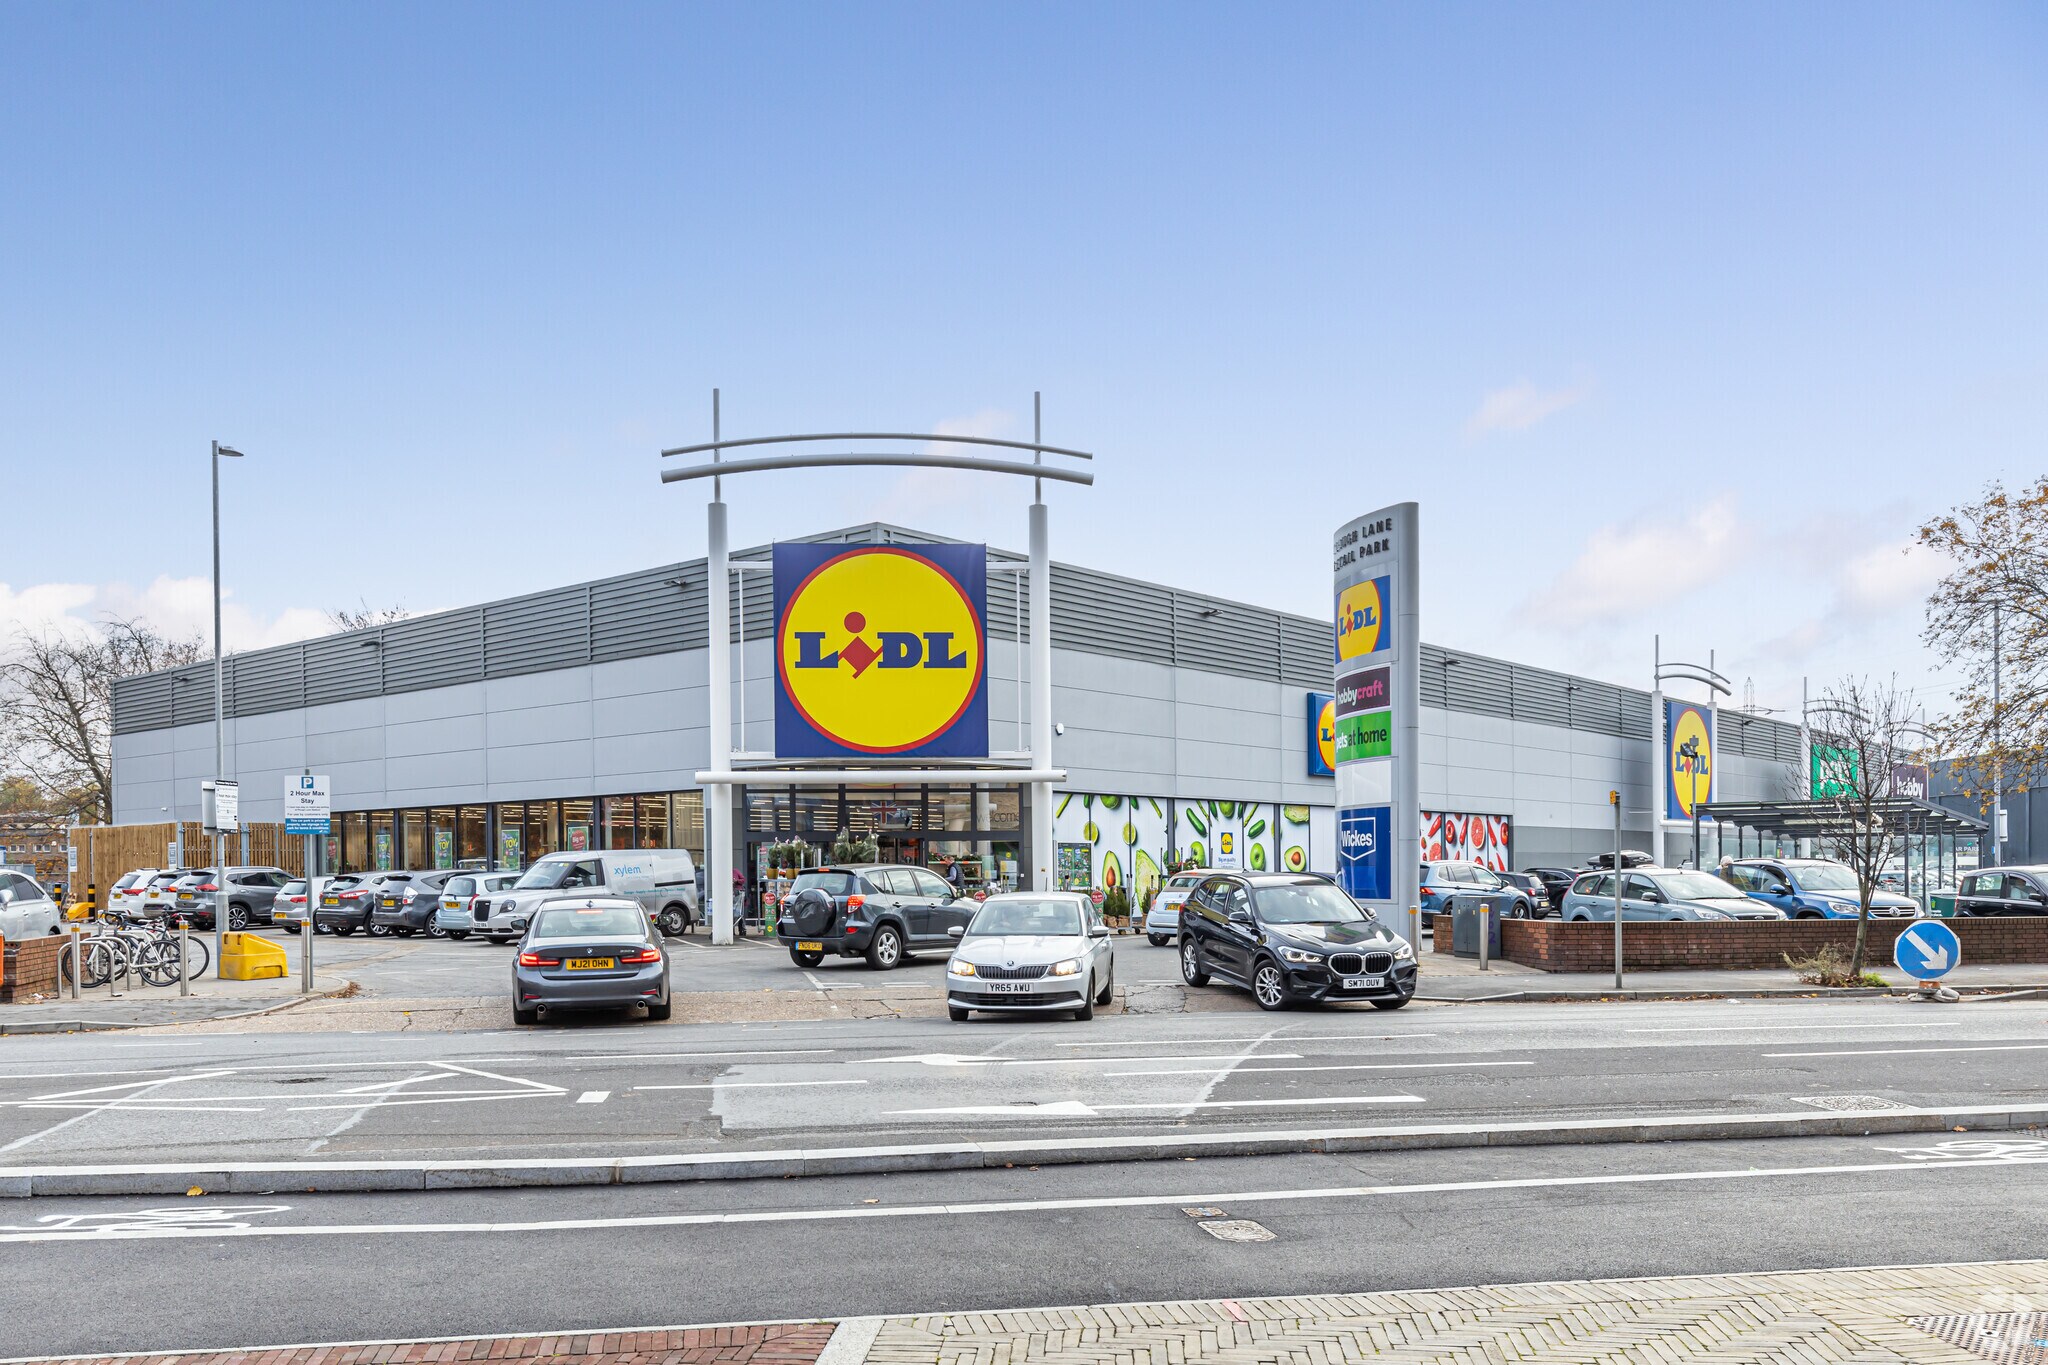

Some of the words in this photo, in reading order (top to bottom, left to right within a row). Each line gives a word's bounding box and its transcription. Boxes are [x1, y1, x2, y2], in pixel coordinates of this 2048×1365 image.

[1362, 517, 1392, 538] LANE
[1360, 538, 1390, 559] PARK
[1337, 680, 1383, 706] hobbycraft
[1336, 732, 1348, 753] pets
[1348, 729, 1356, 747] at
[1358, 727, 1387, 745] home
[439, 841, 450, 850] TOY
[506, 839, 516, 848] TOY
[1341, 830, 1372, 847] Wickes
[614, 865, 642, 876] xylem
